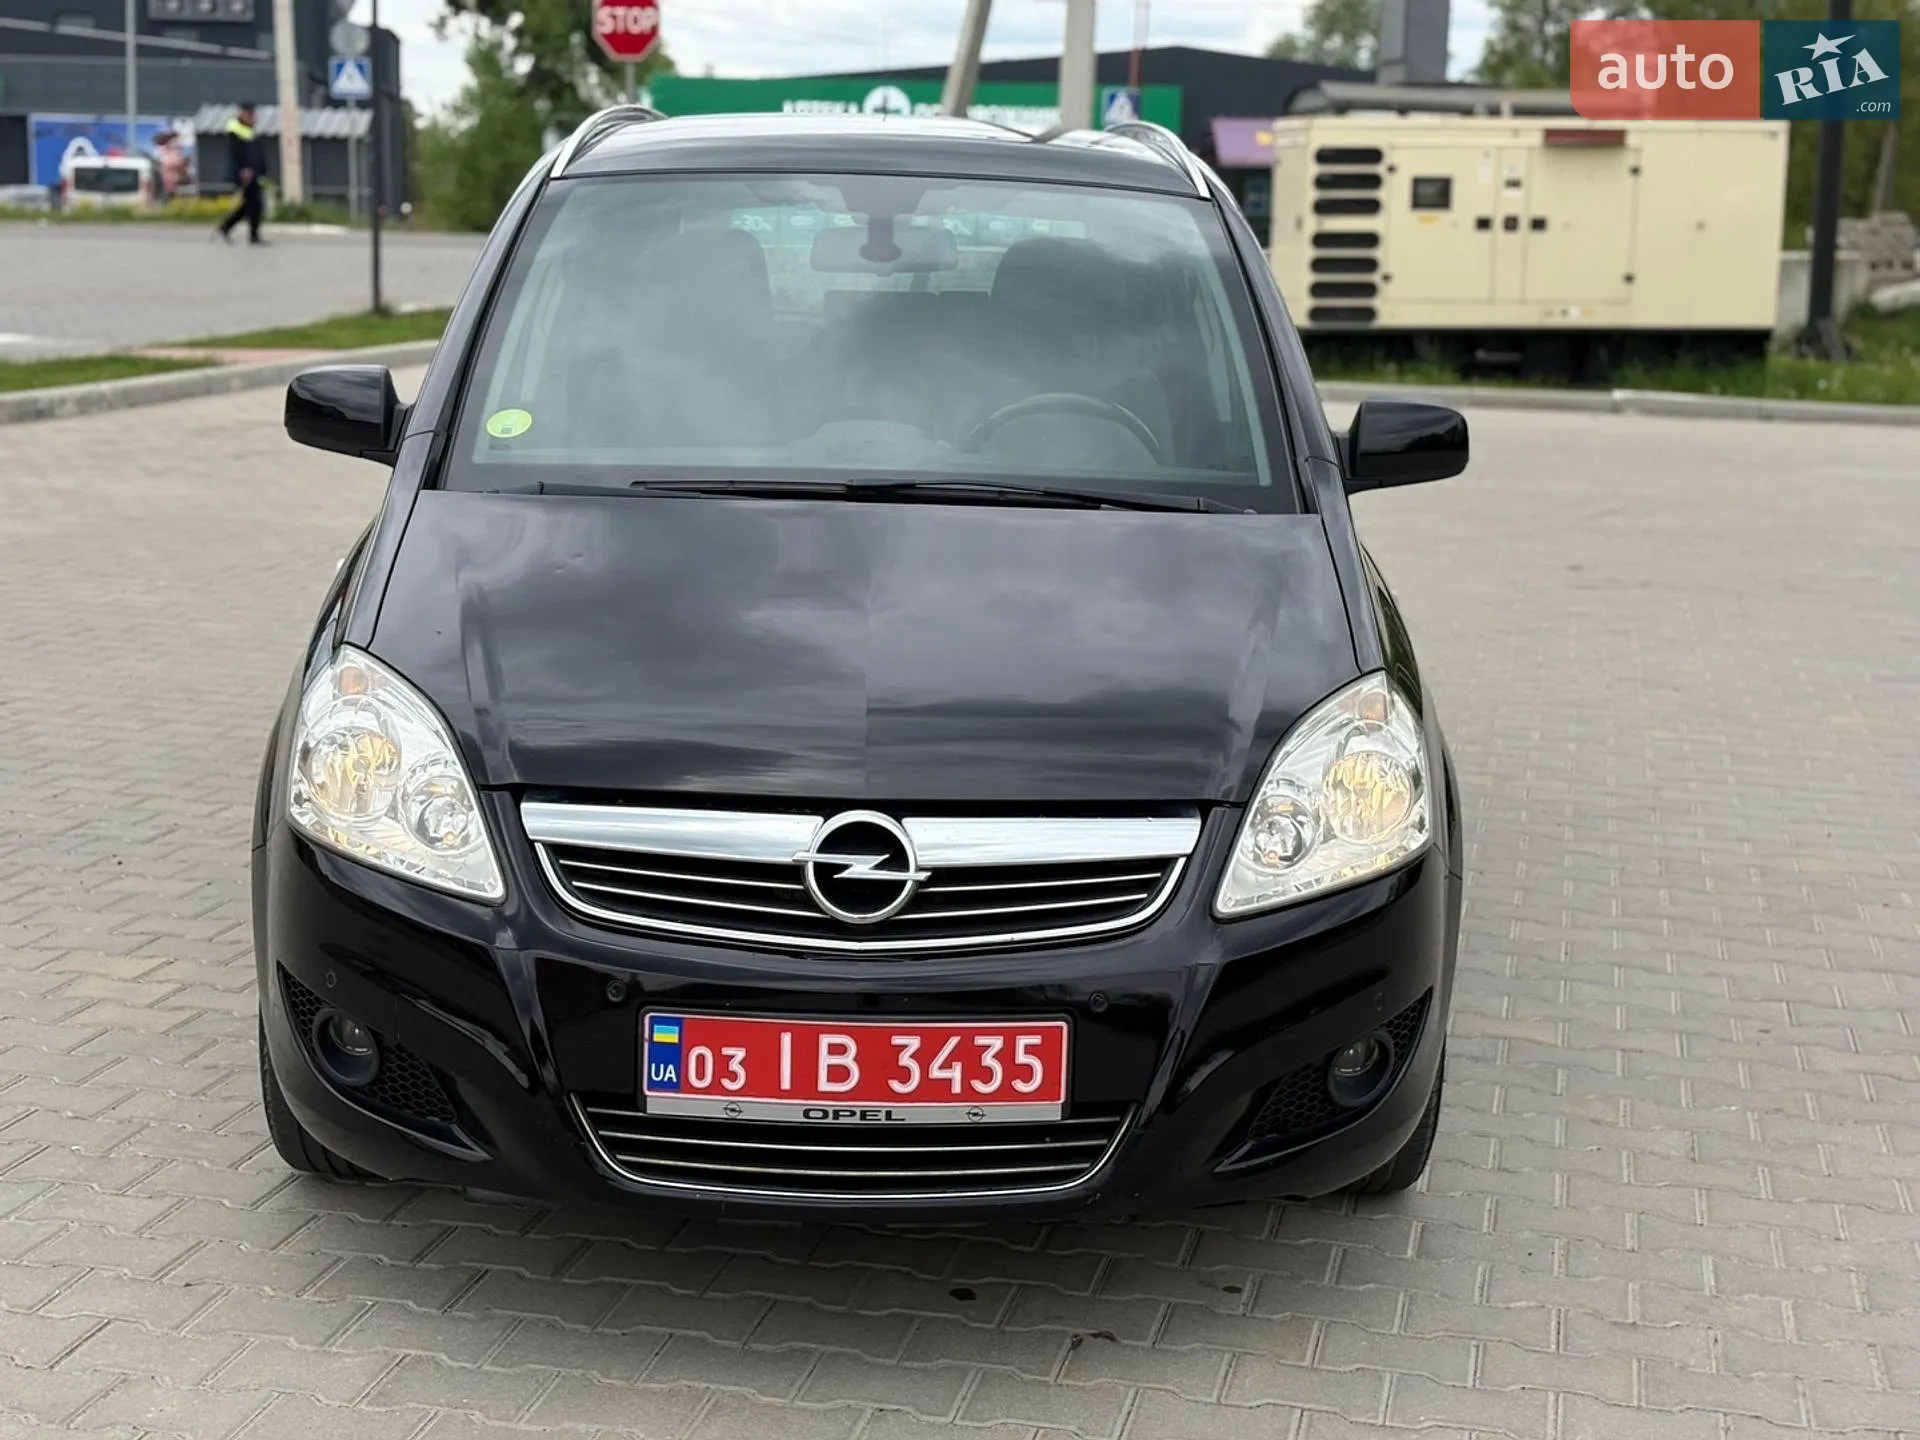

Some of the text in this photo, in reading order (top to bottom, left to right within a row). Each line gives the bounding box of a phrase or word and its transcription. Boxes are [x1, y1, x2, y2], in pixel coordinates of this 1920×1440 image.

[596, 6, 658, 35] STOP
[650, 1063, 677, 1083] UA
[687, 1045, 747, 1091] 03
[888, 1034, 1044, 1095] 3435
[802, 1107, 907, 1122] OPEL
